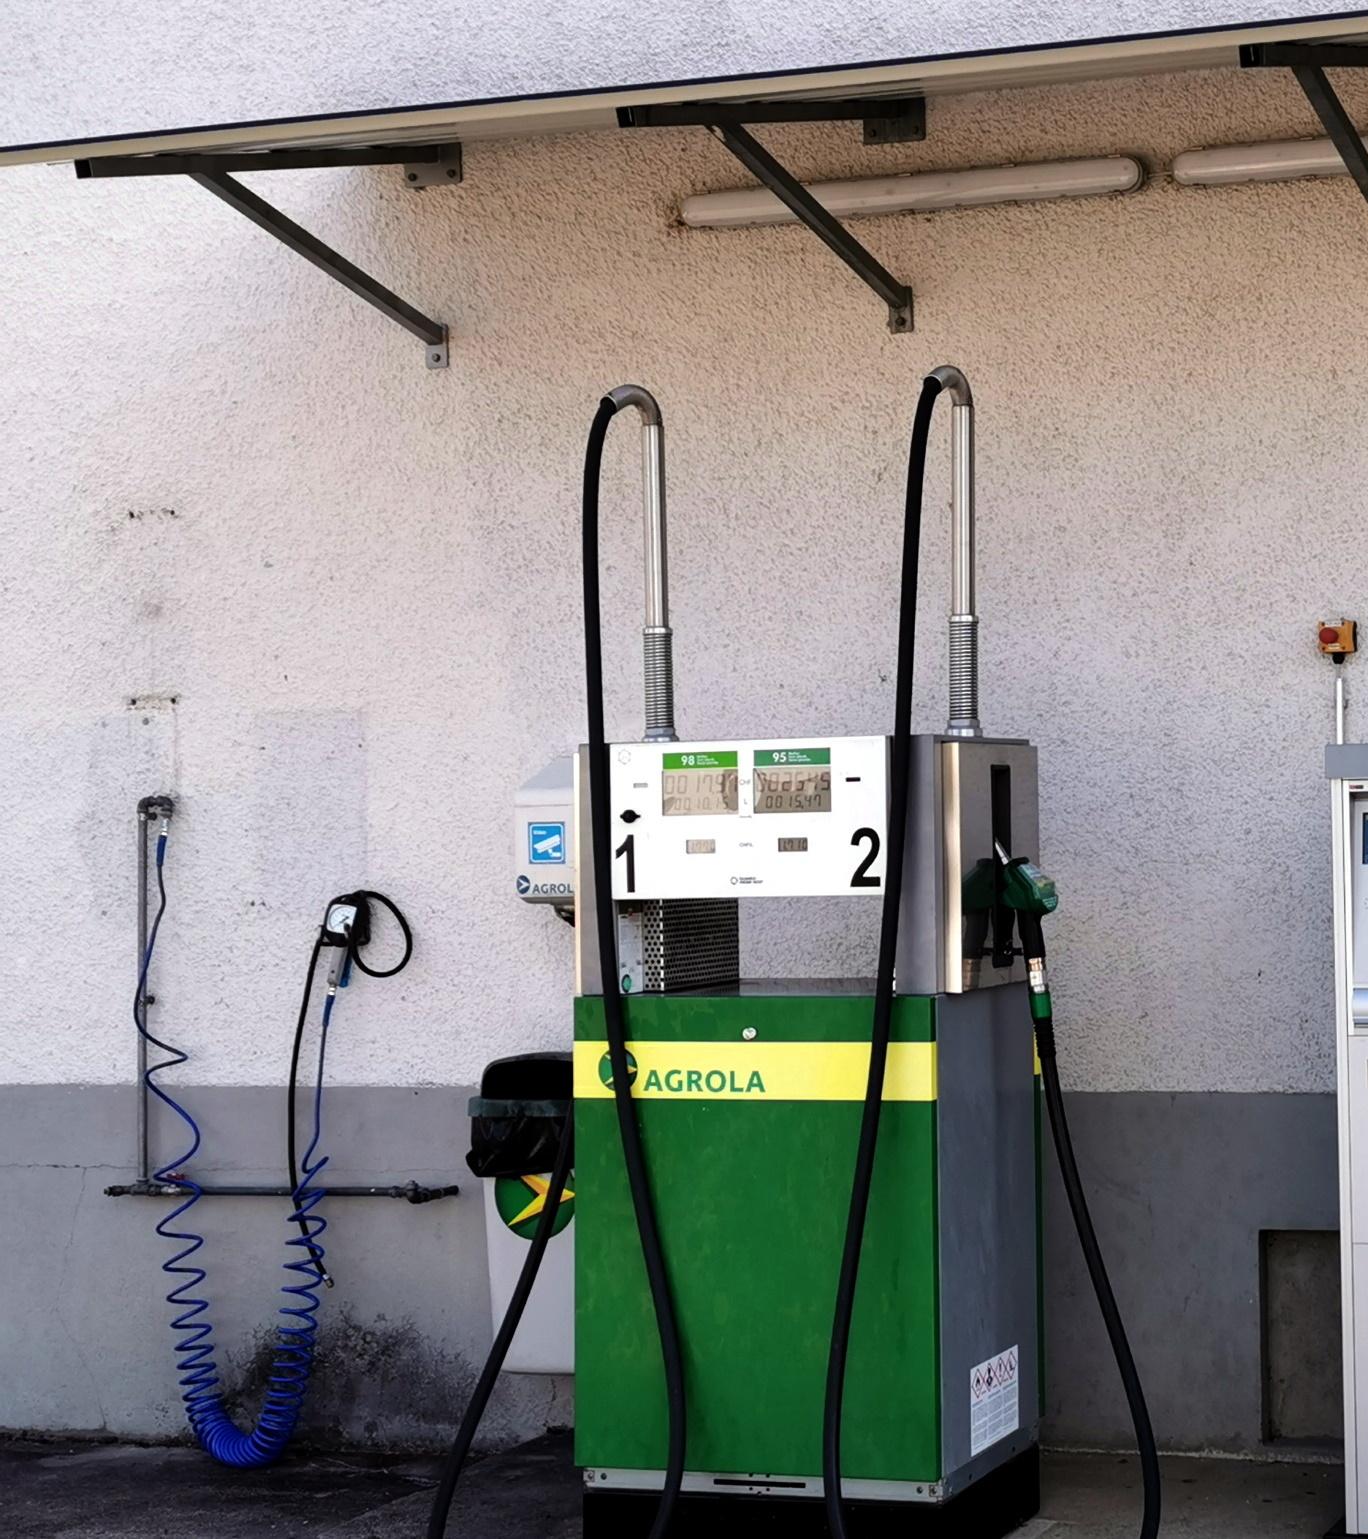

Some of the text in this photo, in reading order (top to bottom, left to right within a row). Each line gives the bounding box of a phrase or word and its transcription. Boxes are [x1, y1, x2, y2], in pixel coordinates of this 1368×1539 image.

[681, 755, 695, 766] 98
[772, 752, 787, 762] 95
[615, 834, 635, 892] 1
[850, 827, 881, 887] 2
[532, 883, 573, 894] AGROL
[643, 1069, 766, 1093] AGROLA
